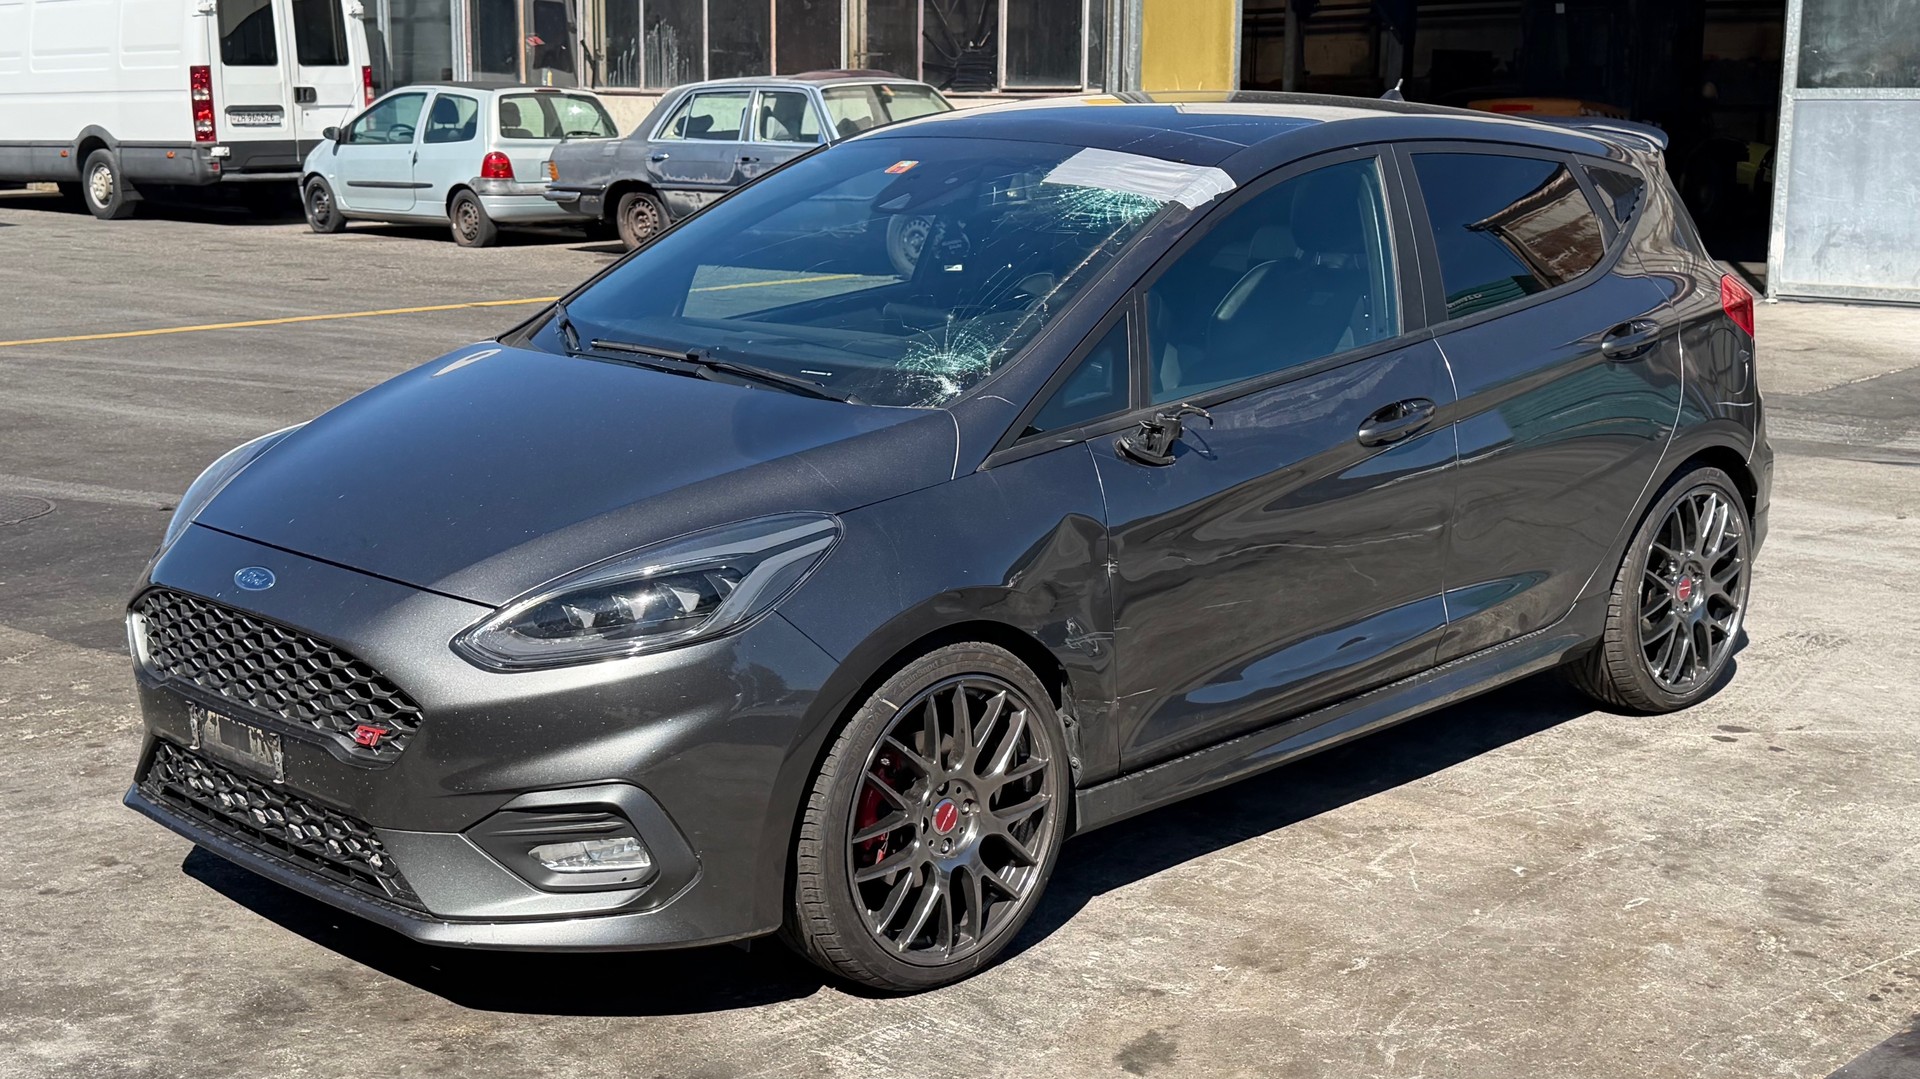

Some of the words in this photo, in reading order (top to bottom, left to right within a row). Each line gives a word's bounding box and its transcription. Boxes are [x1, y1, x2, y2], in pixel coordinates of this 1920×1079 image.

[241, 571, 268, 586] Ford
[899, 659, 940, 689] RainSport
[354, 725, 387, 746] ST
[849, 705, 887, 762] UNIROYAL
